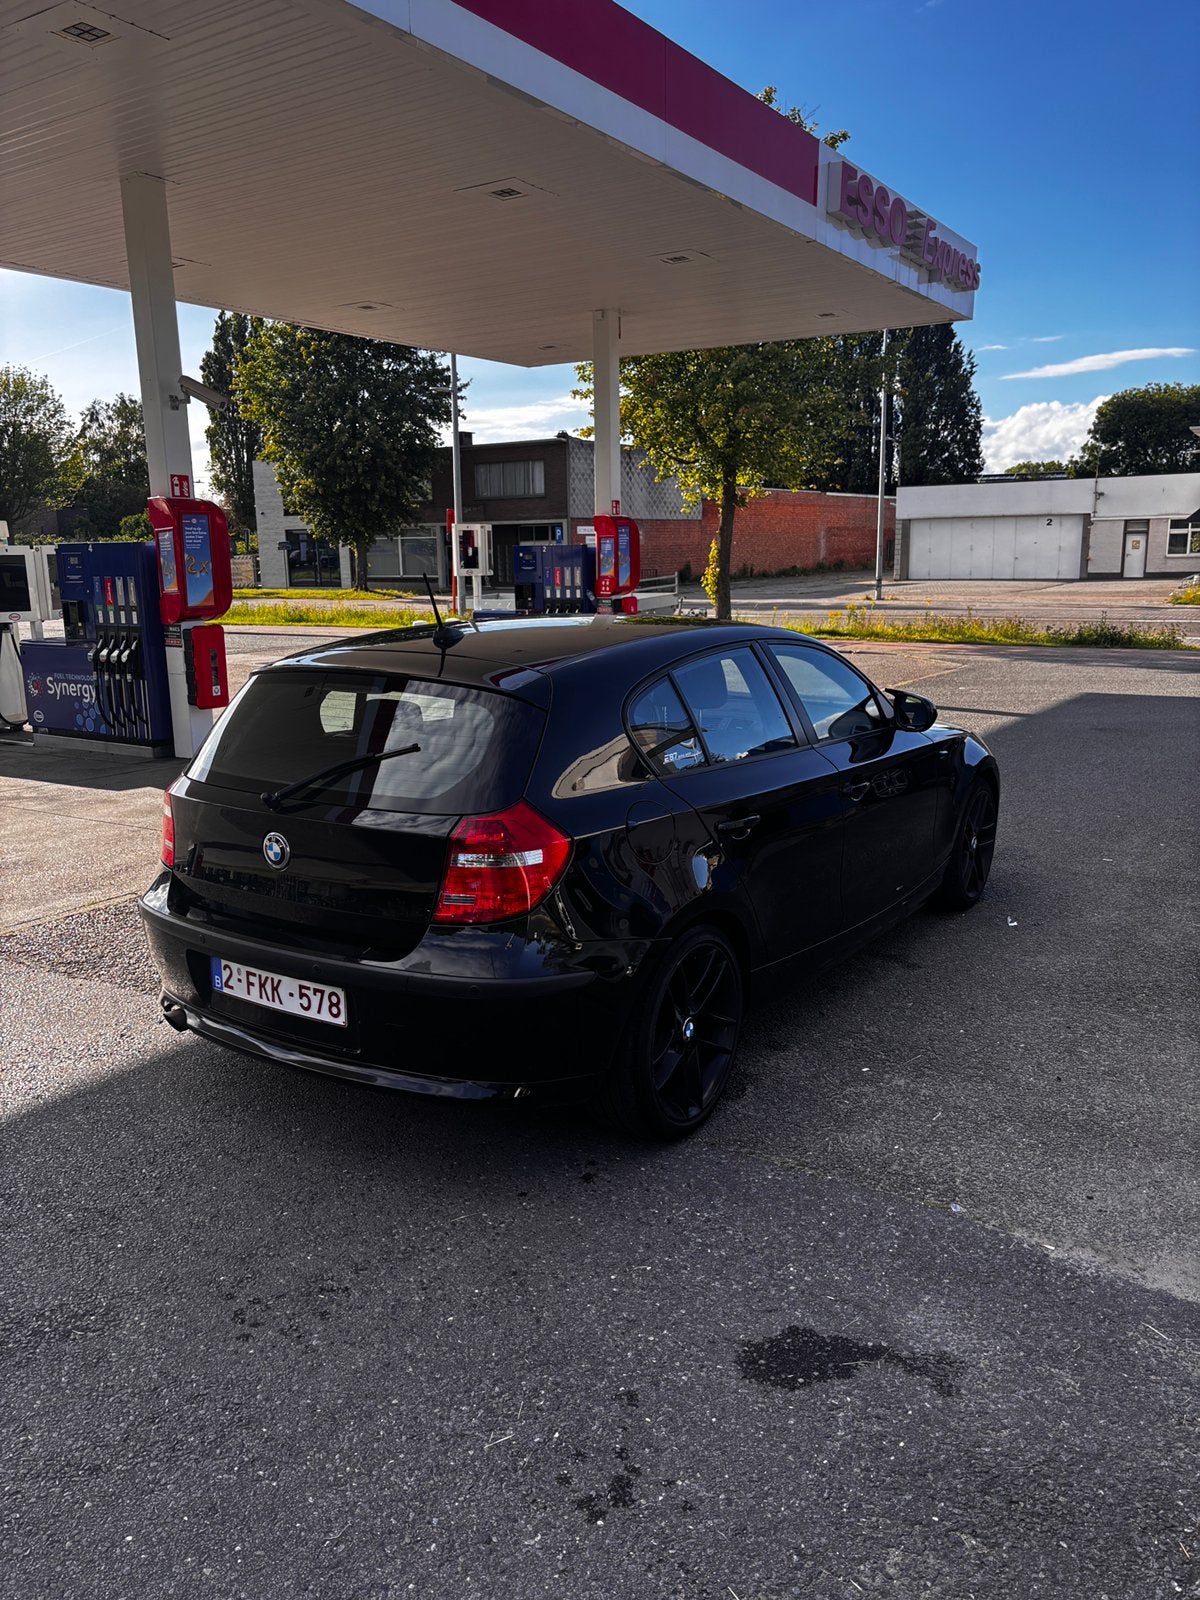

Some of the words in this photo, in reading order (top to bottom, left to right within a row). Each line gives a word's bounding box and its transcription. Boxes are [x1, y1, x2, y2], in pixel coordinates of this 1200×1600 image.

[838, 160, 908, 246] ESSO
[922, 217, 982, 290] Express
[1046, 518, 1053, 526] 2
[556, 528, 562, 539] P
[88, 544, 93, 553] 4
[542, 545, 547, 553] 2
[54, 672, 65, 680] FUEL
[46, 676, 97, 703] Synergy
[214, 974, 222, 988] B
[222, 963, 342, 1019] 2-FKK-578
